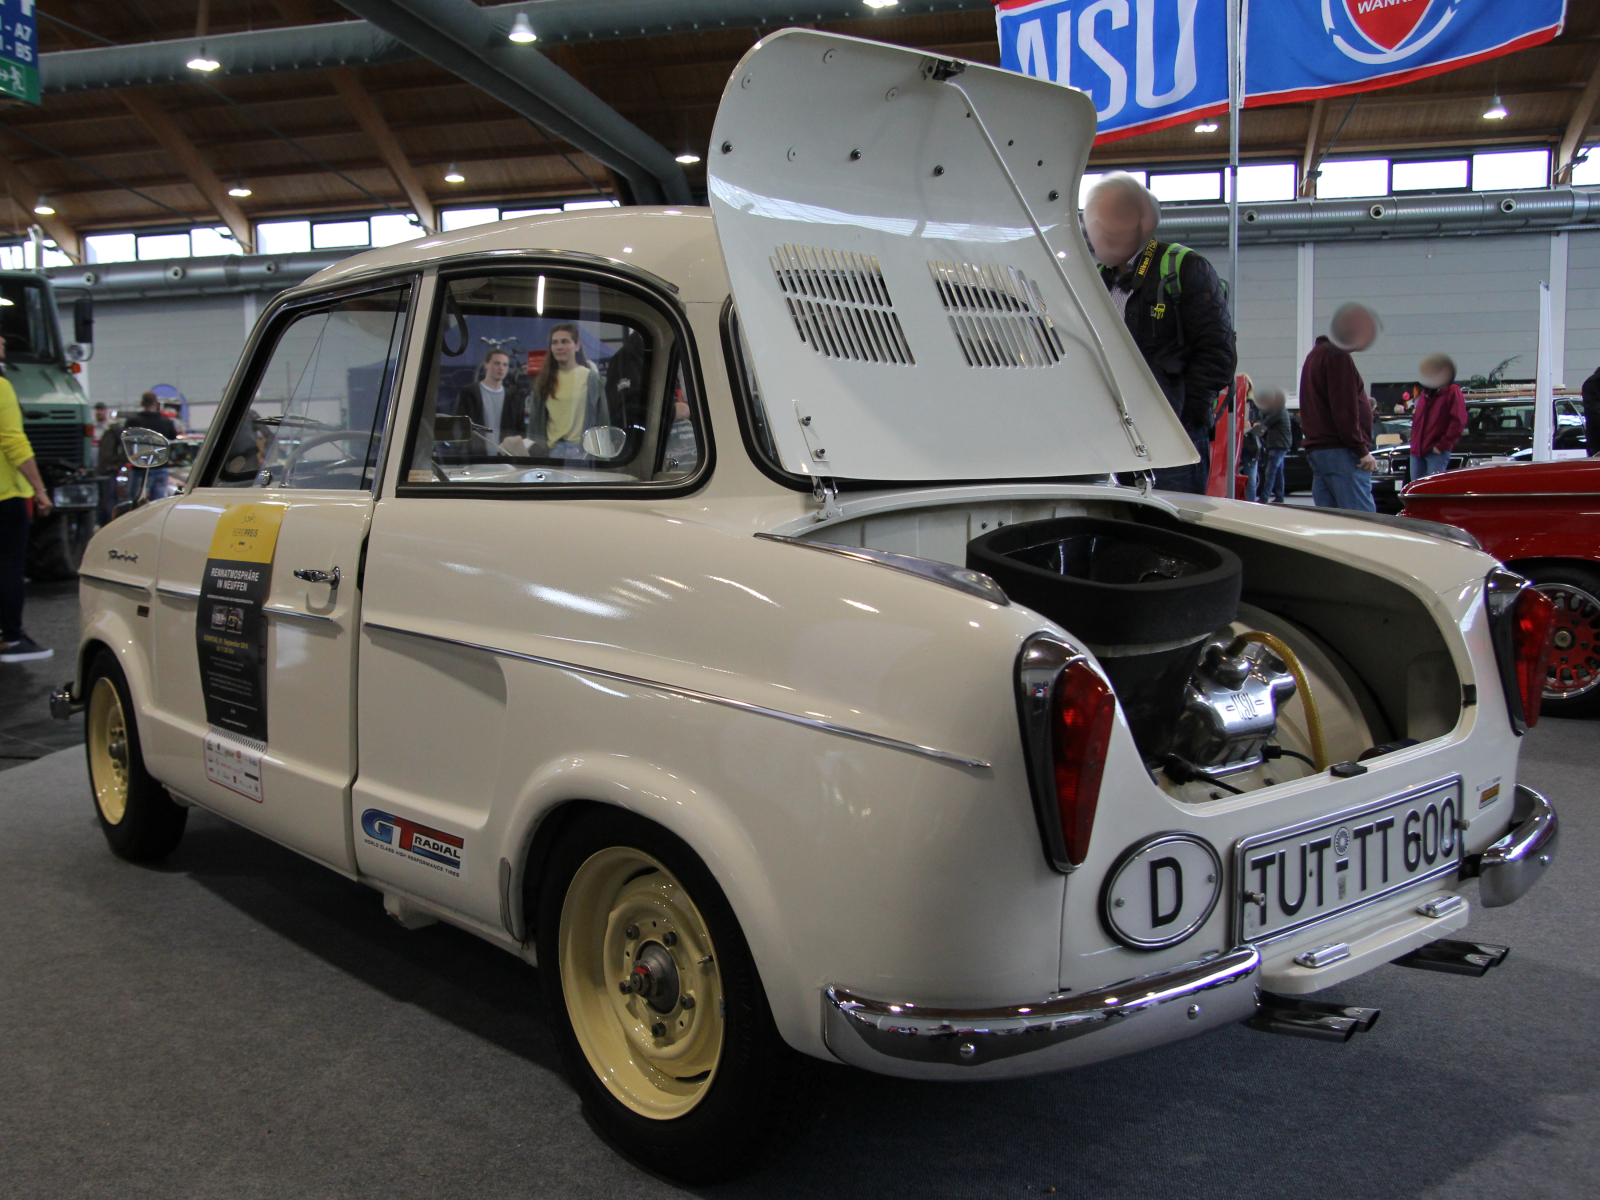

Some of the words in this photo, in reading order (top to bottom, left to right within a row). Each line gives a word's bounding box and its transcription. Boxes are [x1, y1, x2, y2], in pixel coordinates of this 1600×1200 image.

[14, 22, 33, 42] A7
[15, 41, 33, 63] B5
[1016, 0, 1198, 123] NSU
[1139, 257, 1150, 275] Nikon
[210, 567, 260, 582] RENNATMOSPHÄRE
[216, 579, 223, 589] IN
[223, 580, 248, 592] NEUFFEN
[1230, 692, 1258, 721] NSU
[1403, 796, 1455, 873] 600
[364, 838, 380, 848] WORLD
[380, 844, 395, 854] CLASS
[395, 850, 406, 858] HIGH
[407, 855, 443, 872] PERFORMANCE
[445, 868, 460, 878] TIRES
[413, 836, 461, 860] RADIAL
[1149, 856, 1183, 929] D
